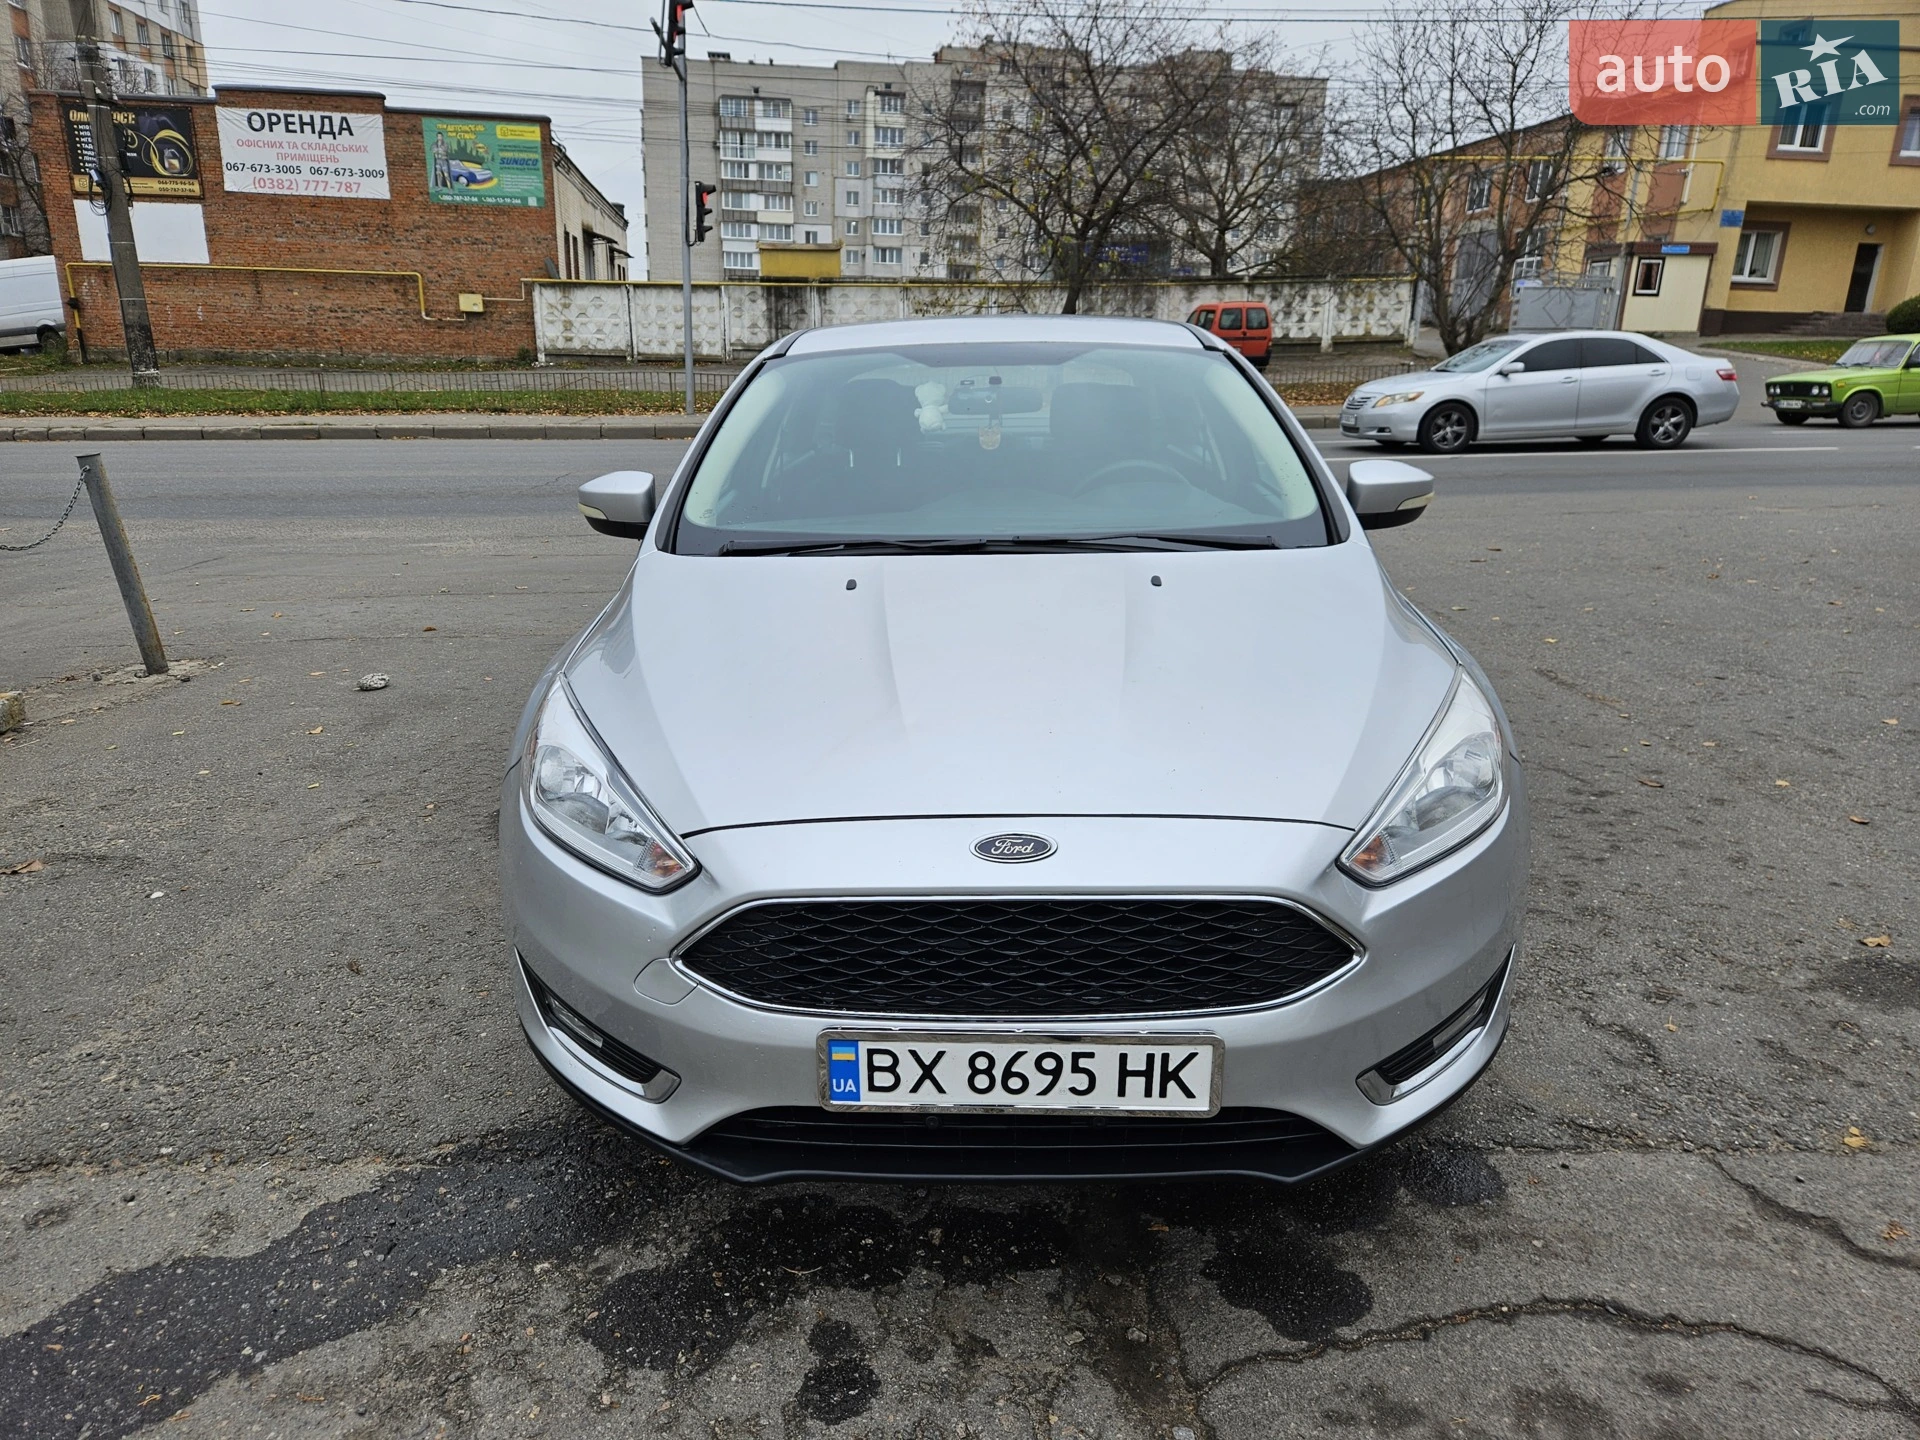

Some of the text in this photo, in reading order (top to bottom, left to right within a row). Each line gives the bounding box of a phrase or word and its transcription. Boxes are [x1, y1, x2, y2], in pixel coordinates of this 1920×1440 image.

[111, 111, 135, 123] ОСТ:
[247, 111, 354, 140] ОРЕНДА
[236, 138, 369, 154] ОФІСНИХ ТА СКЛАДСЬКИХ
[276, 152, 340, 164] ПРИМІЩЕНЬ
[499, 157, 539, 167] SUNOCO
[225, 161, 385, 179] 067-673-3005 067-673-3009
[253, 176, 361, 194] (0382) 777-787
[990, 838, 1035, 855] Ford
[866, 1047, 1199, 1099] BX 8695 HK
[832, 1078, 857, 1093] UA
